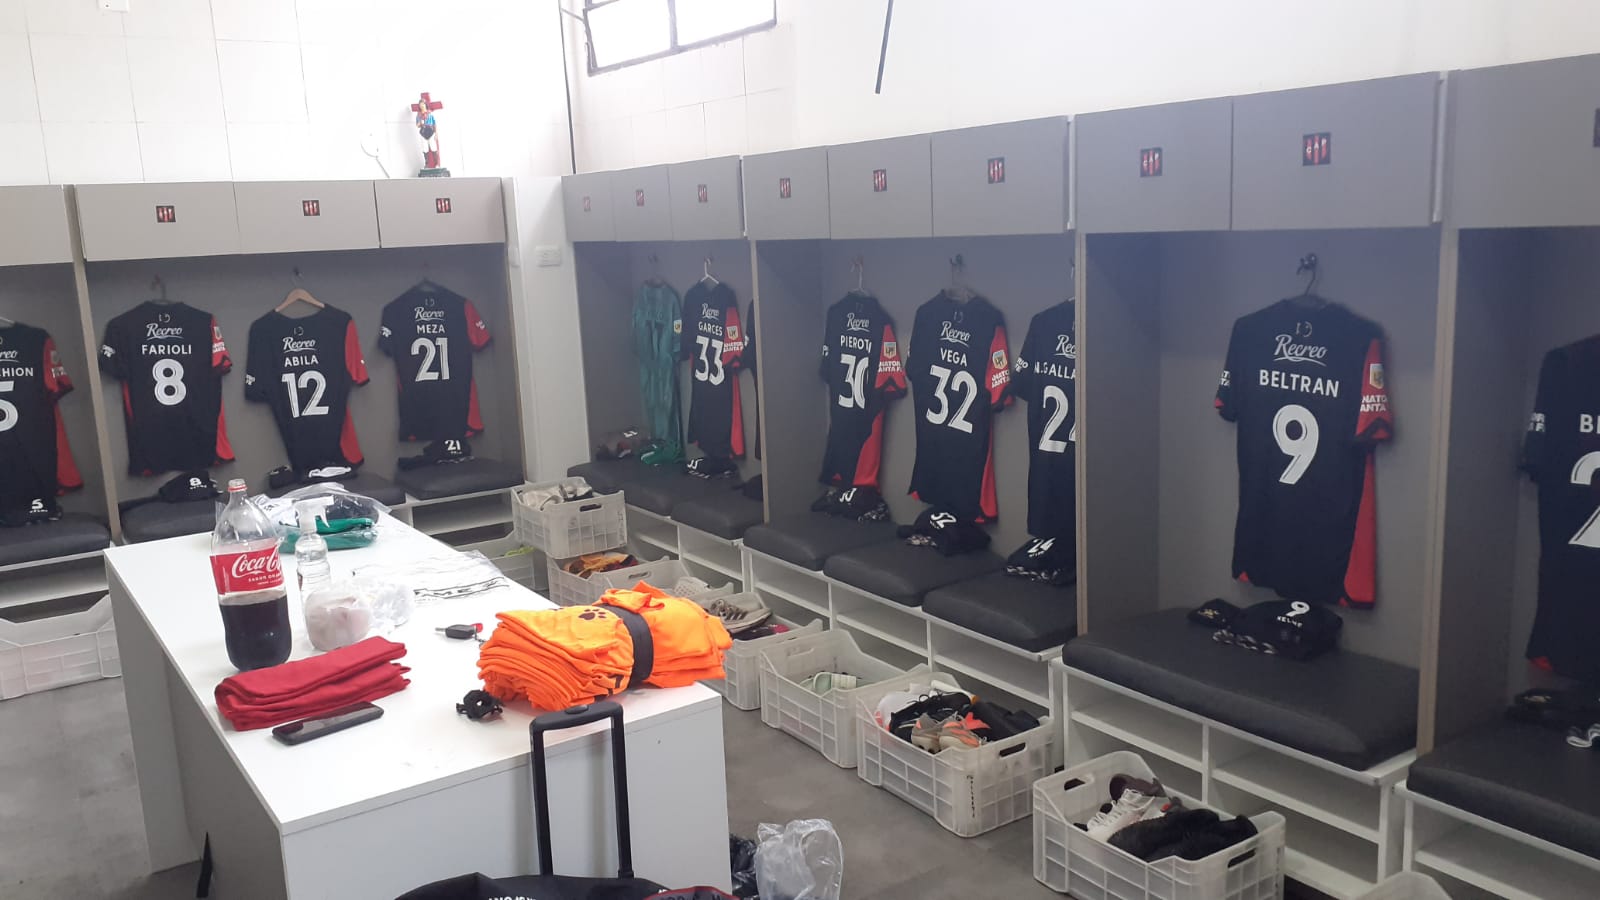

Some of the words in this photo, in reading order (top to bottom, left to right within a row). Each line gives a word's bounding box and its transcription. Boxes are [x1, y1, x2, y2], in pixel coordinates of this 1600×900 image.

[414, 307, 445, 321] Recreo
[847, 313, 870, 331] Recreo
[146, 323, 184, 339] Recreo
[416, 324, 446, 334] MEZA
[698, 321, 723, 337] GARCES
[941, 321, 970, 346] Recreo
[141, 344, 192, 355] FARIOLI
[283, 337, 317, 352] Recreo
[1055, 334, 1076, 356] Rec
[1274, 334, 1328, 366] Recreo
[0, 350, 18, 359] reo
[284, 355, 319, 367] ABILA
[411, 337, 450, 382] 21
[695, 335, 725, 386] 33
[940, 348, 968, 367] VEGA
[0, 367, 34, 377] HION
[152, 358, 187, 406] 8
[1259, 369, 1340, 398] BELTRAN
[281, 371, 330, 418] 12
[926, 365, 978, 433] 32
[1038, 386, 1076, 453] 2
[1579, 413, 1600, 434] B
[445, 439, 461, 451] 21
[1272, 404, 1319, 485] 9
[189, 477, 202, 487] 8
[31, 498, 43, 510] 5
[1286, 600, 1310, 617] 9
